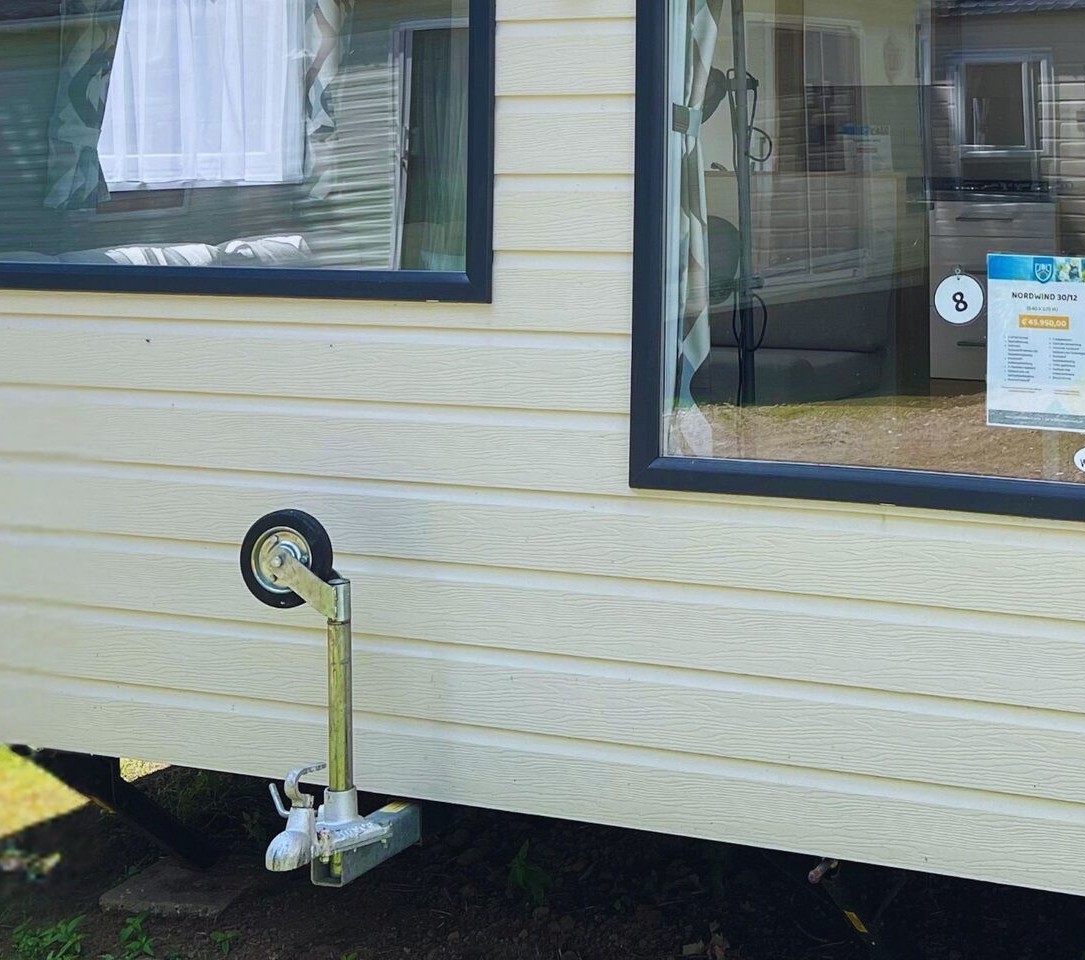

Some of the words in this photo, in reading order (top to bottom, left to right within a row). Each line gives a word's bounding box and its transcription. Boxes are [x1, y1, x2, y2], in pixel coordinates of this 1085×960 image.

[952, 291, 968, 312] 8
[1012, 292, 1055, 300] NORDWIND
[1057, 294, 1078, 302] 30/12
